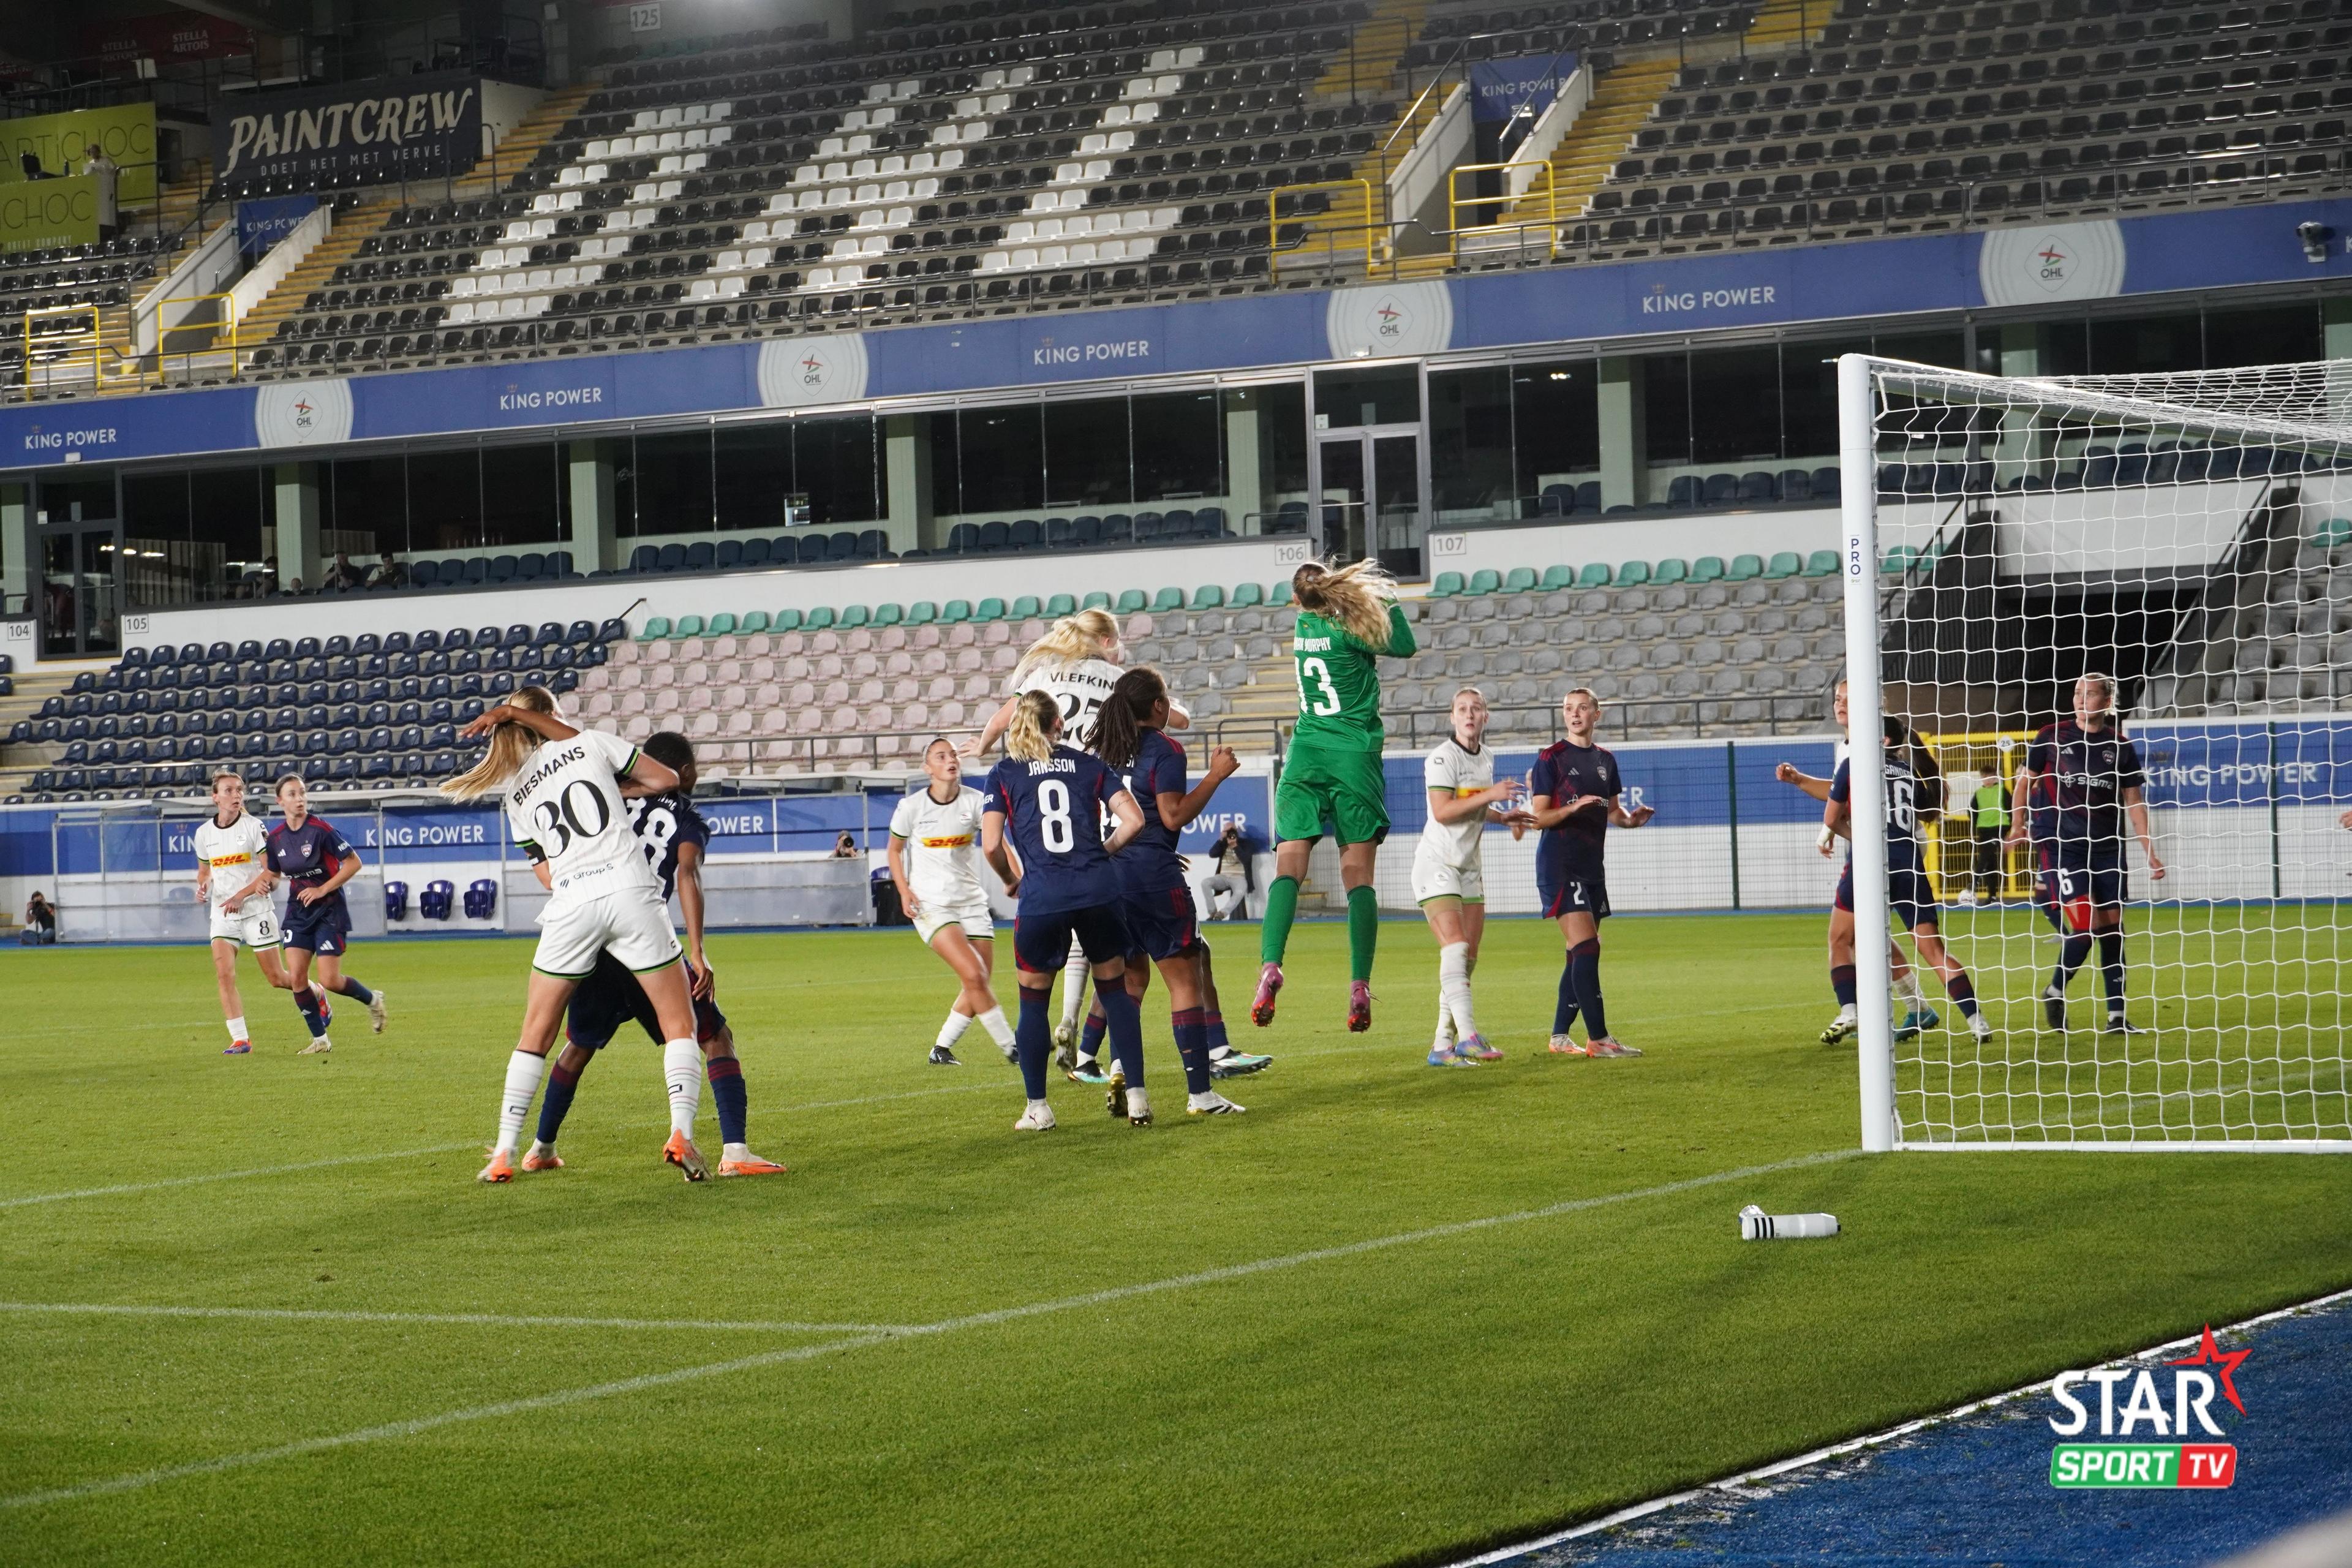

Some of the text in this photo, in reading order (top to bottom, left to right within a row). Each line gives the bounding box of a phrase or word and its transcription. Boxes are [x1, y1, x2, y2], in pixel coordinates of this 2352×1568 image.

[633, 9, 658, 28] 125
[173, 29, 209, 43] STELLA
[173, 40, 209, 53] ARTOIS
[1482, 77, 1567, 97] KING POWER
[219, 88, 473, 178] PAINTCREW
[261, 145, 441, 176] DOET HET MET VERVE
[4, 190, 91, 230] CHOC
[246, 221, 272, 233] KING
[2040, 268, 2063, 279] OHL
[1643, 286, 1775, 314] KING POWER
[1380, 324, 1399, 336] OHL
[1033, 340, 1149, 366] KING POWER
[804, 375, 821, 384] OHL
[500, 387, 602, 410] KING POWER
[296, 416, 312, 428] OHL
[24, 428, 116, 450] KING POWER
[1436, 537, 1463, 552] 107
[1279, 548, 1304, 561] 106
[1850, 538, 1861, 575] PRO
[9, 625, 29, 637] 104
[126, 617, 147, 631] 105
[513, 747, 586, 806] BIESMANS
[1028, 759, 1076, 777] JANSSON
[2141, 765, 2208, 787] KING
[535, 780, 609, 858] 30
[706, 815, 763, 834] OWER
[1038, 779, 1074, 853] 8
[1181, 813, 1246, 834] OWER
[168, 835, 197, 853] KIN
[366, 824, 484, 846] KNG POWER
[930, 836, 971, 847] DHL
[213, 854, 246, 867] DHL
[2059, 868, 2073, 895] 6
[1570, 881, 1585, 905] 2
[260, 921, 270, 935] 8
